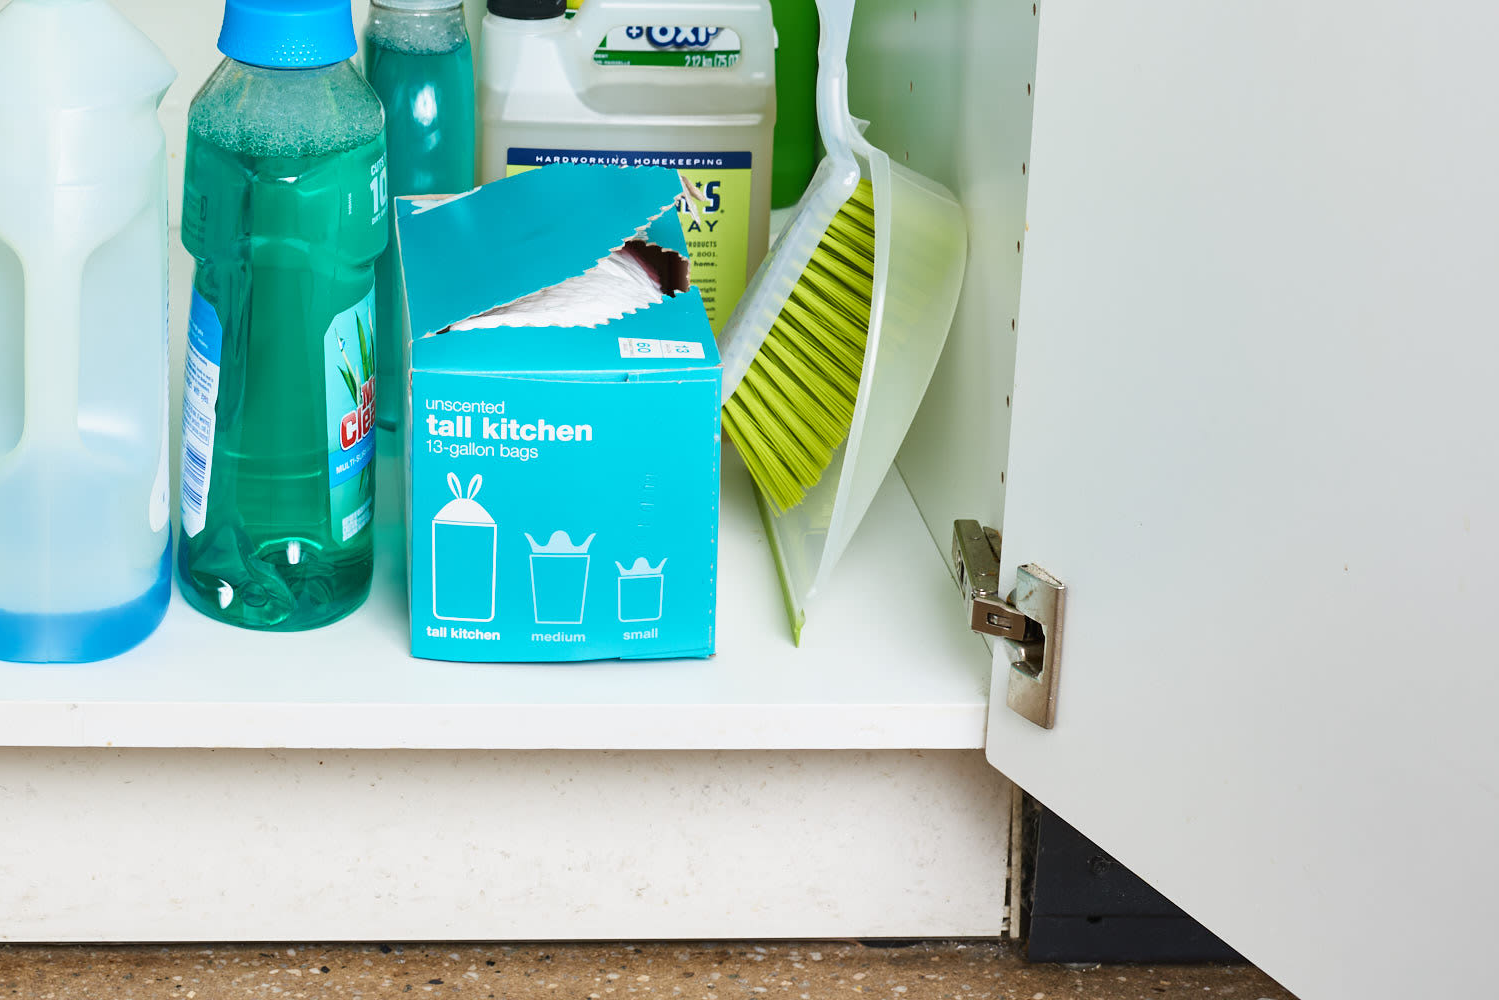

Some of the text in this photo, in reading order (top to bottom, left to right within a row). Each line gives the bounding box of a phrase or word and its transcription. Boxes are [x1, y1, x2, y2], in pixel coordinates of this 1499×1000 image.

[536, 155, 723, 166] HARDWORKING HOMEKEEPING
[425, 399, 504, 414] unscented
[426, 416, 592, 441] tall kitchen
[426, 440, 538, 461] 13-gallon bags
[426, 626, 500, 641] tall kitchen
[531, 633, 585, 642] medium
[623, 629, 658, 640] small
